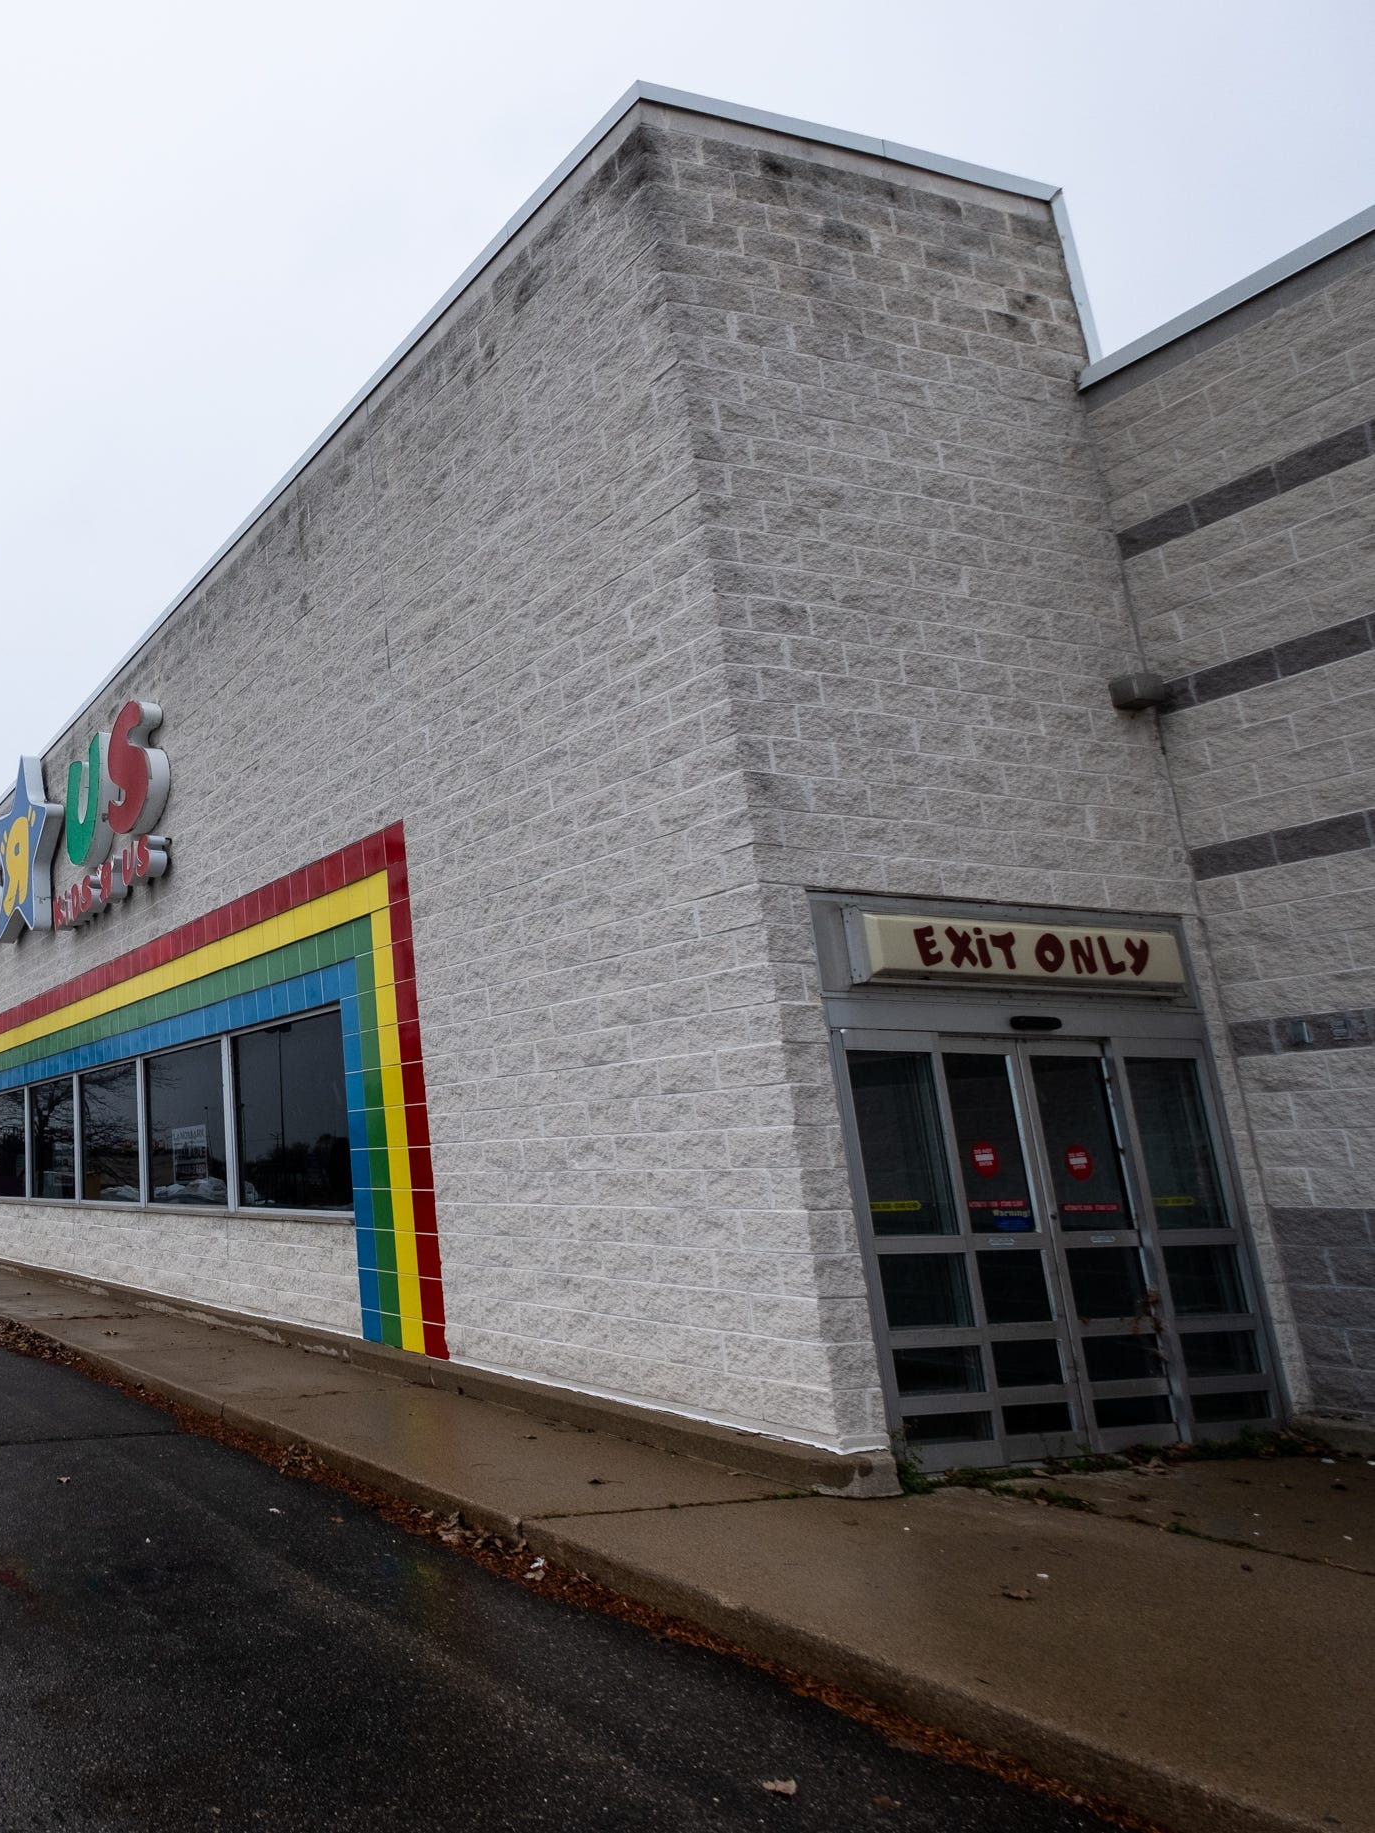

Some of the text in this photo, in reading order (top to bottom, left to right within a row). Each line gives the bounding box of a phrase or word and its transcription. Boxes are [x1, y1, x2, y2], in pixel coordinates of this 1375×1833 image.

[66, 700, 152, 867] US
[122, 835, 152, 887] US
[1035, 932, 1150, 977] ONLY
